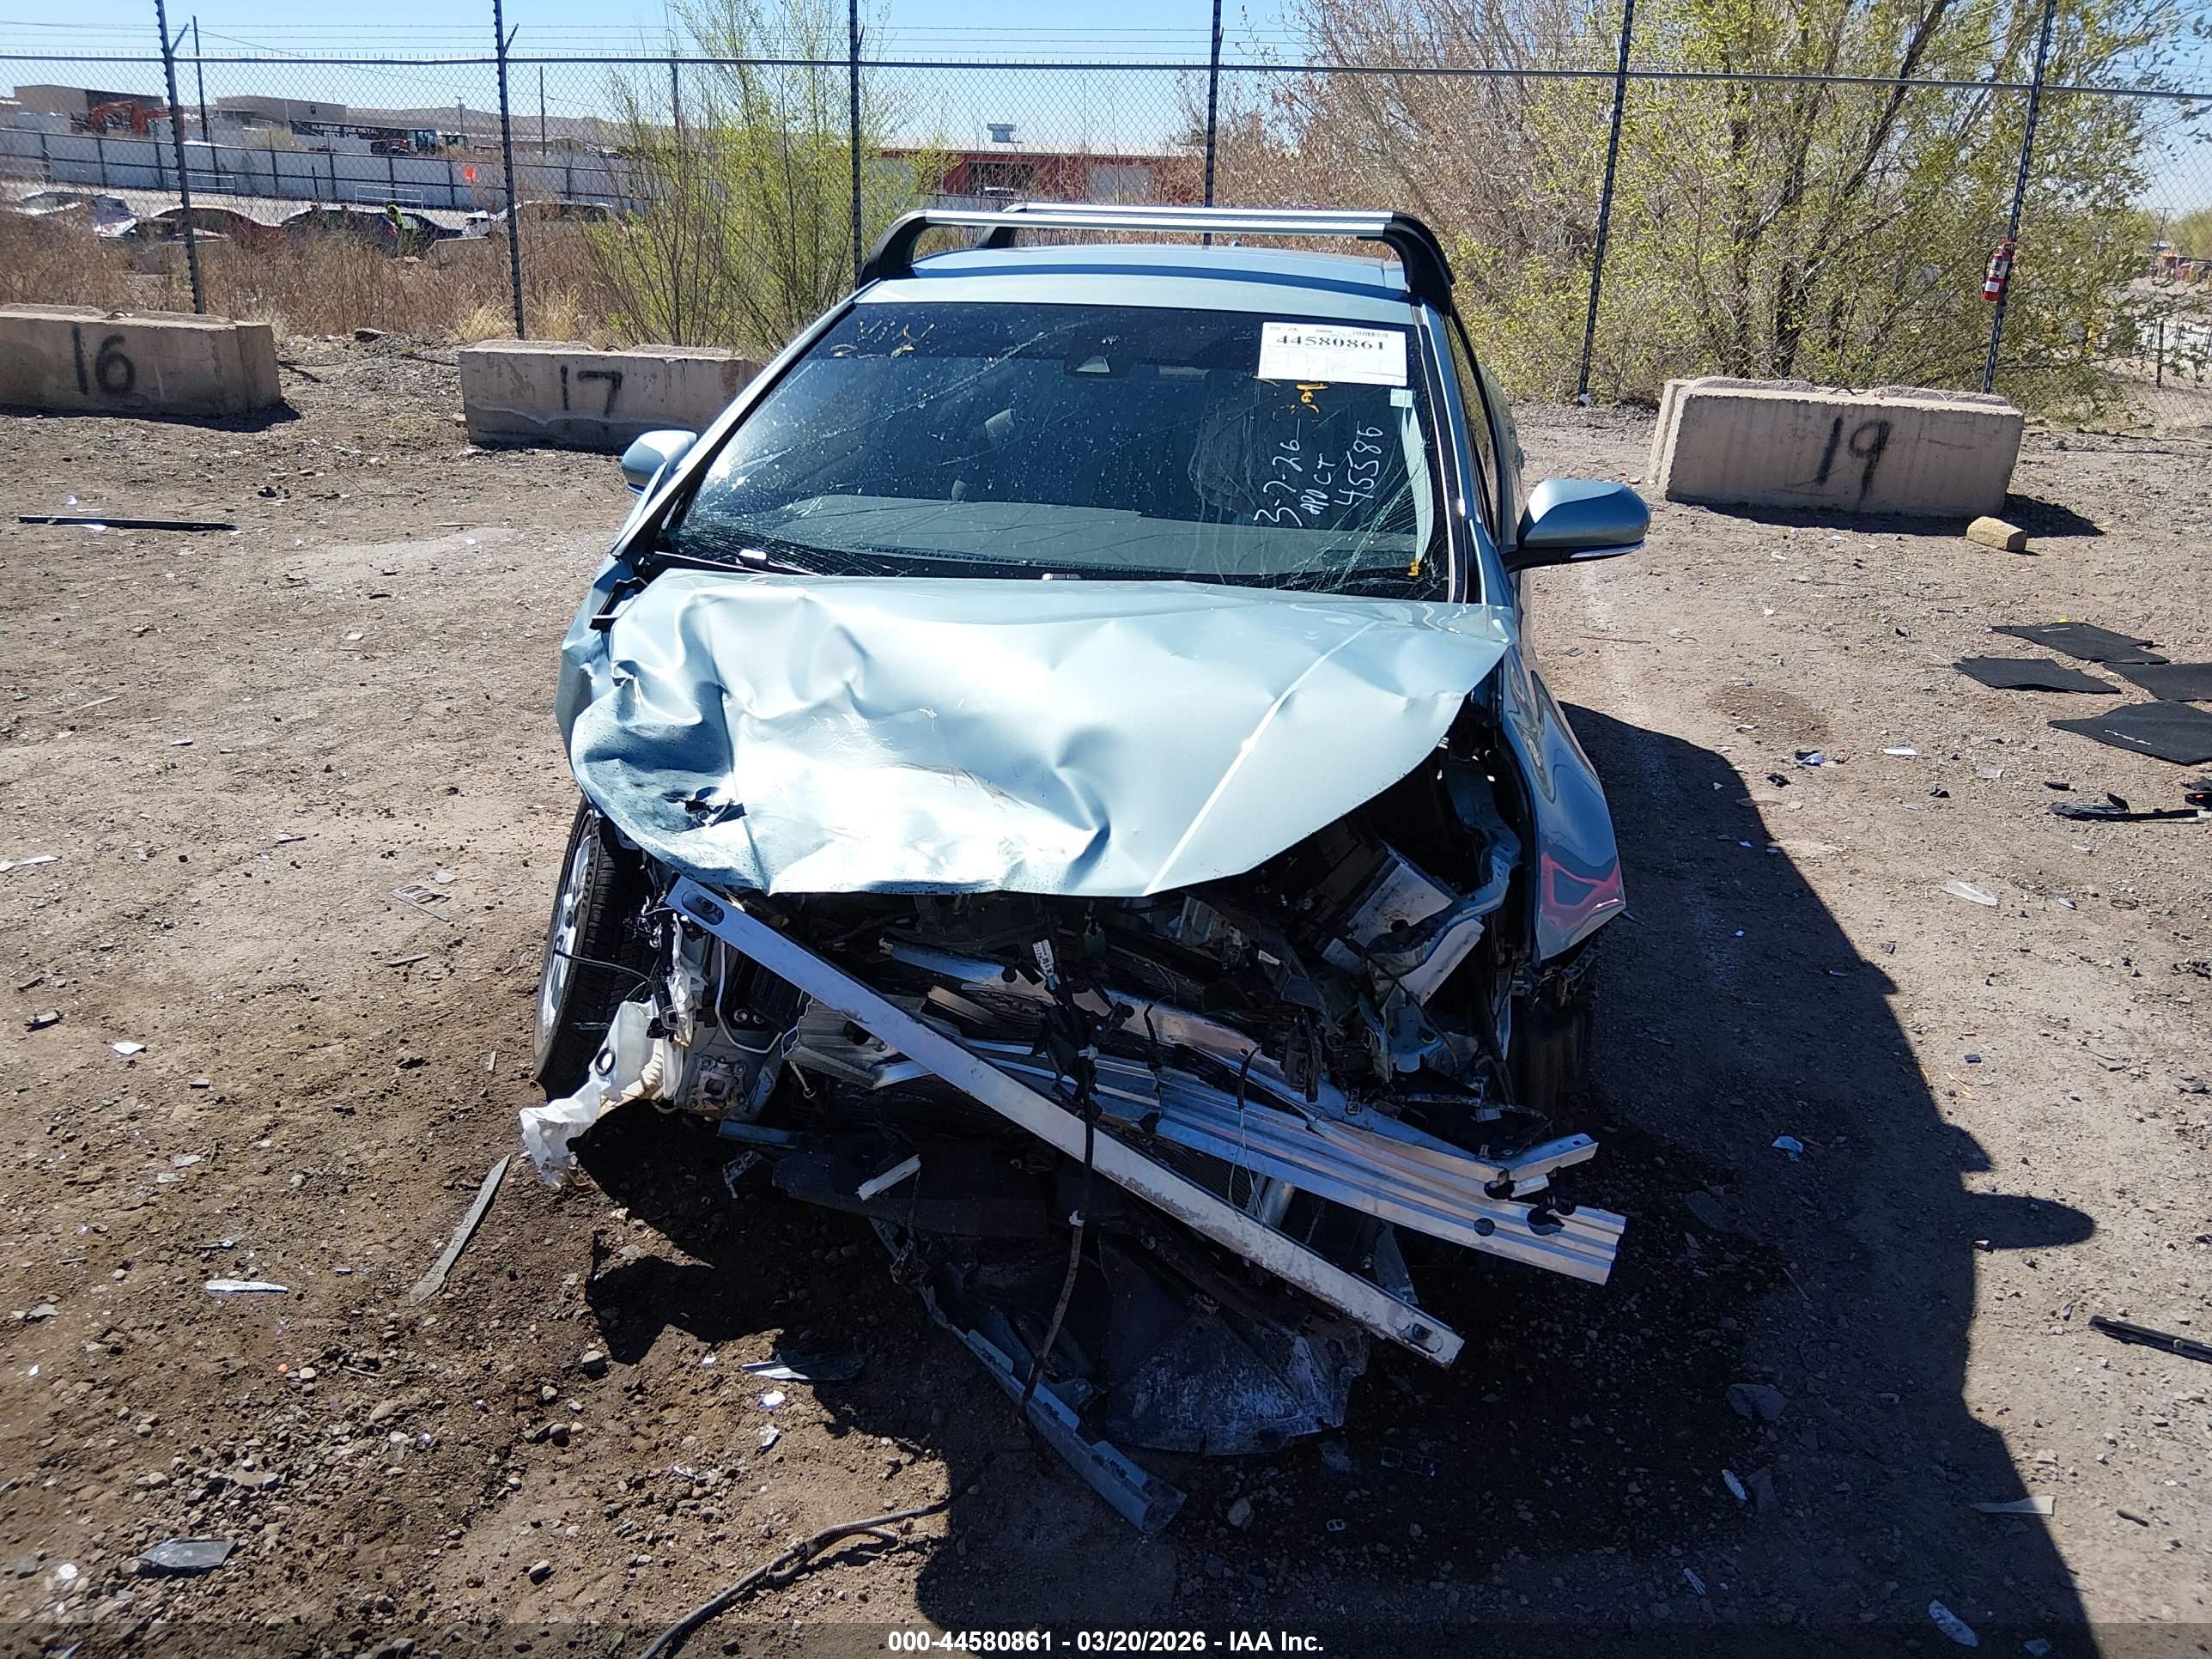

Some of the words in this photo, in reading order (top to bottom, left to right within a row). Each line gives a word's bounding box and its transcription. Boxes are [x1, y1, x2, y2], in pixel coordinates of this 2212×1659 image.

[71, 326, 137, 397] 16
[1276, 334, 1384, 351] 44580861
[561, 365, 623, 419] 17
[1814, 416, 1892, 502] 19
